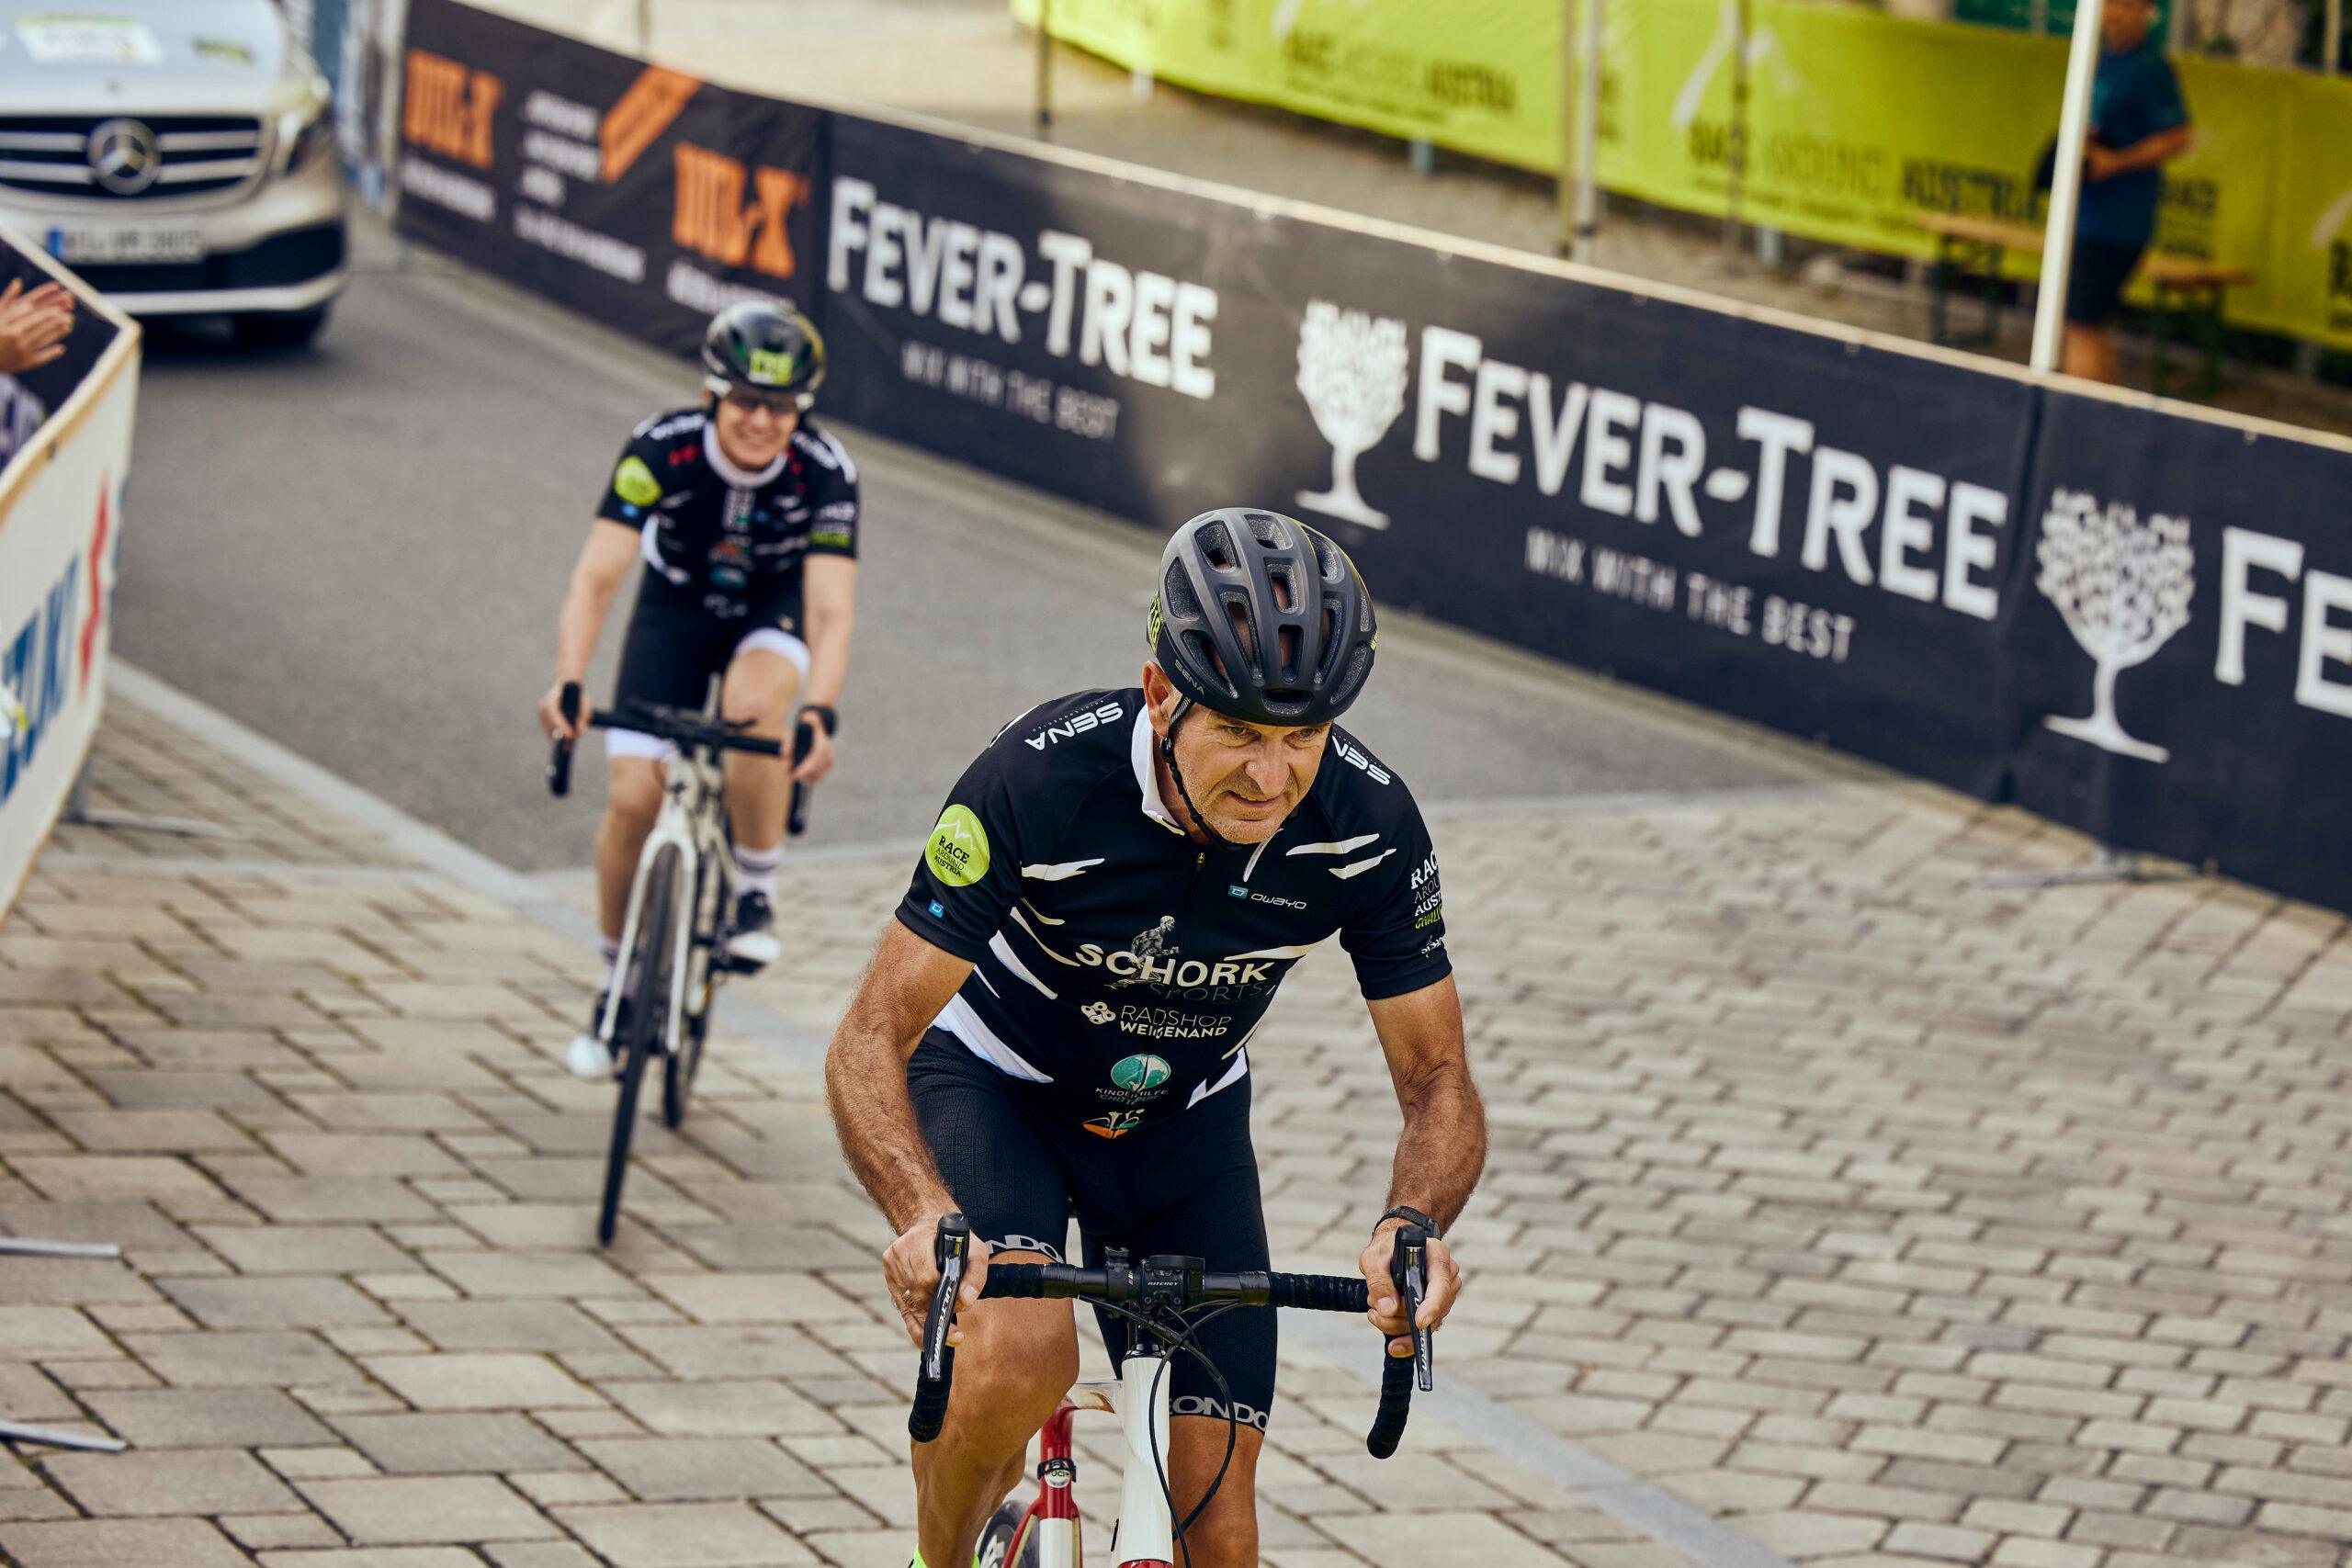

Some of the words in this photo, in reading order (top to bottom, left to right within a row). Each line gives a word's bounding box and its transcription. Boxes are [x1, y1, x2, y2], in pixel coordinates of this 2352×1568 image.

[828, 175, 1217, 400] FEVER-TREE
[1412, 325, 2009, 622] FEVER-TREE
[1524, 525, 1586, 585] MIX
[1592, 546, 1677, 612] WITH
[1685, 571, 1753, 635] THE
[1761, 595, 1856, 663] BEST
[1175, 659, 1204, 695] SENA
[1024, 702, 1123, 750] SENA
[934, 854, 962, 877] AUSTRIA
[935, 847, 965, 871] AROUND
[938, 834, 970, 863] RACE
[1075, 943, 1275, 987] SCHORK
[1121, 1005, 1232, 1028] RADSHOP
[933, 1286, 952, 1360] ULTEGRA
[1169, 1395, 1269, 1432] ONDO
